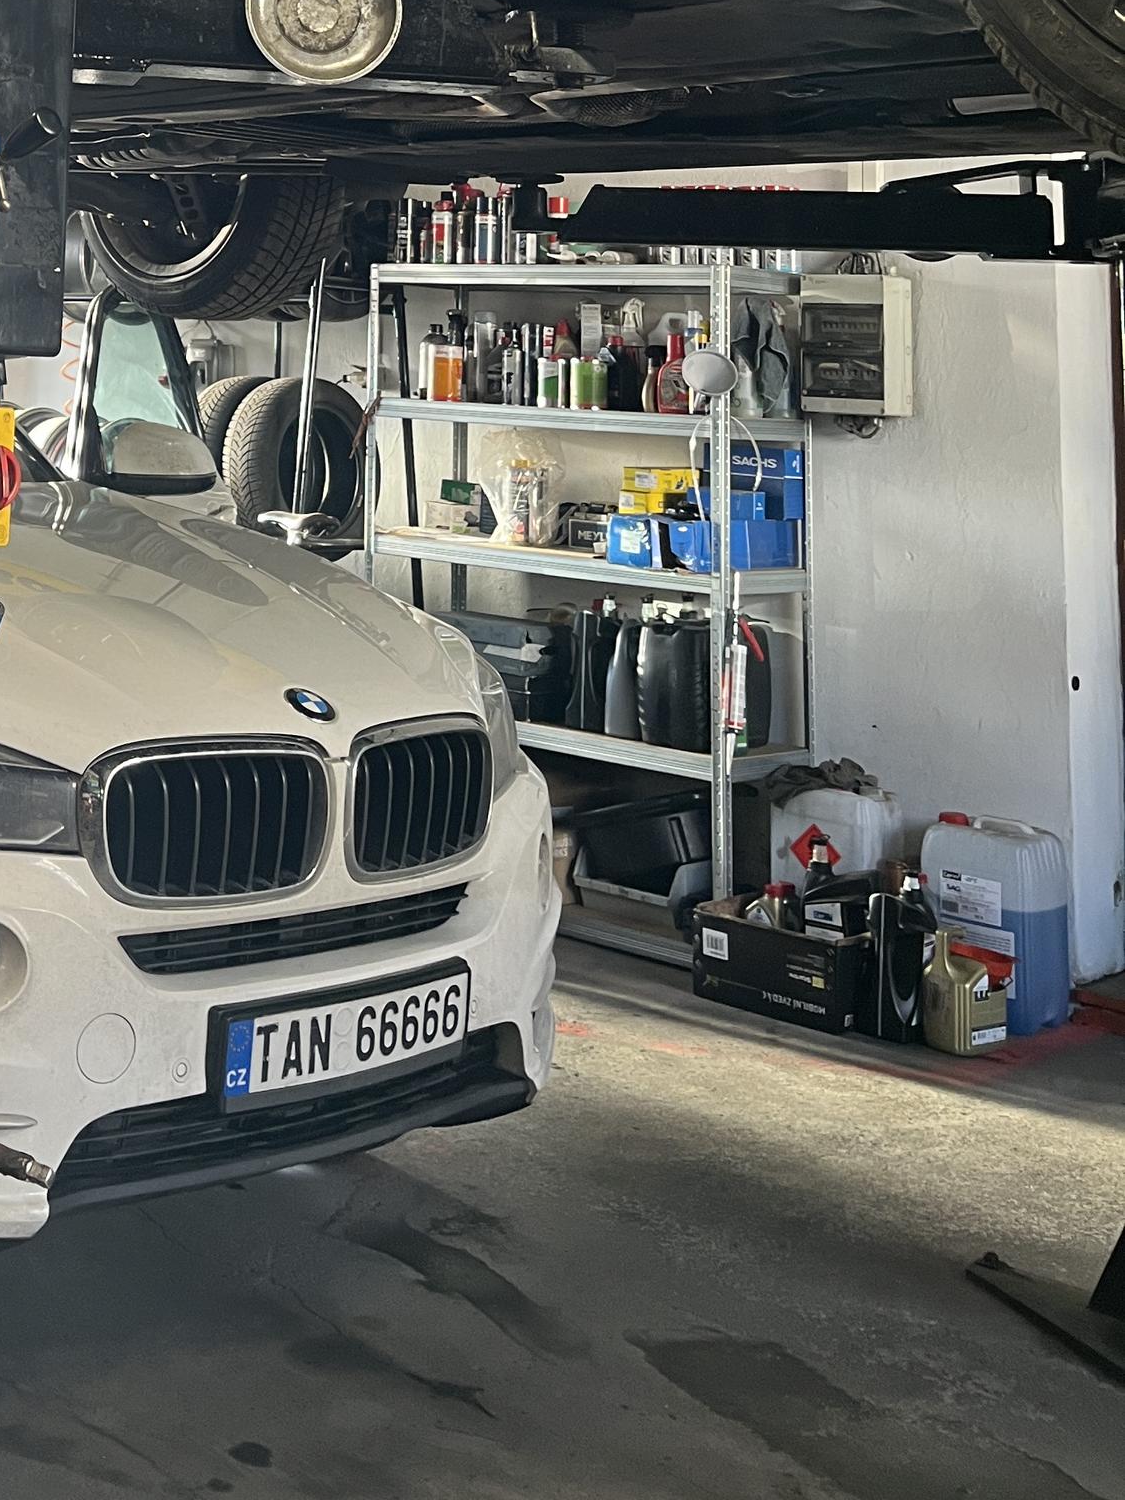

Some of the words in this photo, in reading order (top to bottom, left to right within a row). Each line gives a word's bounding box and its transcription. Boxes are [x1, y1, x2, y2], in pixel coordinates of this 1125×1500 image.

[732, 455, 778, 469] SACHS
[578, 530, 605, 542] MEYL
[256, 1013, 332, 1083] TAN
[356, 984, 461, 1062] 66666
[226, 1069, 247, 1089] CZ
